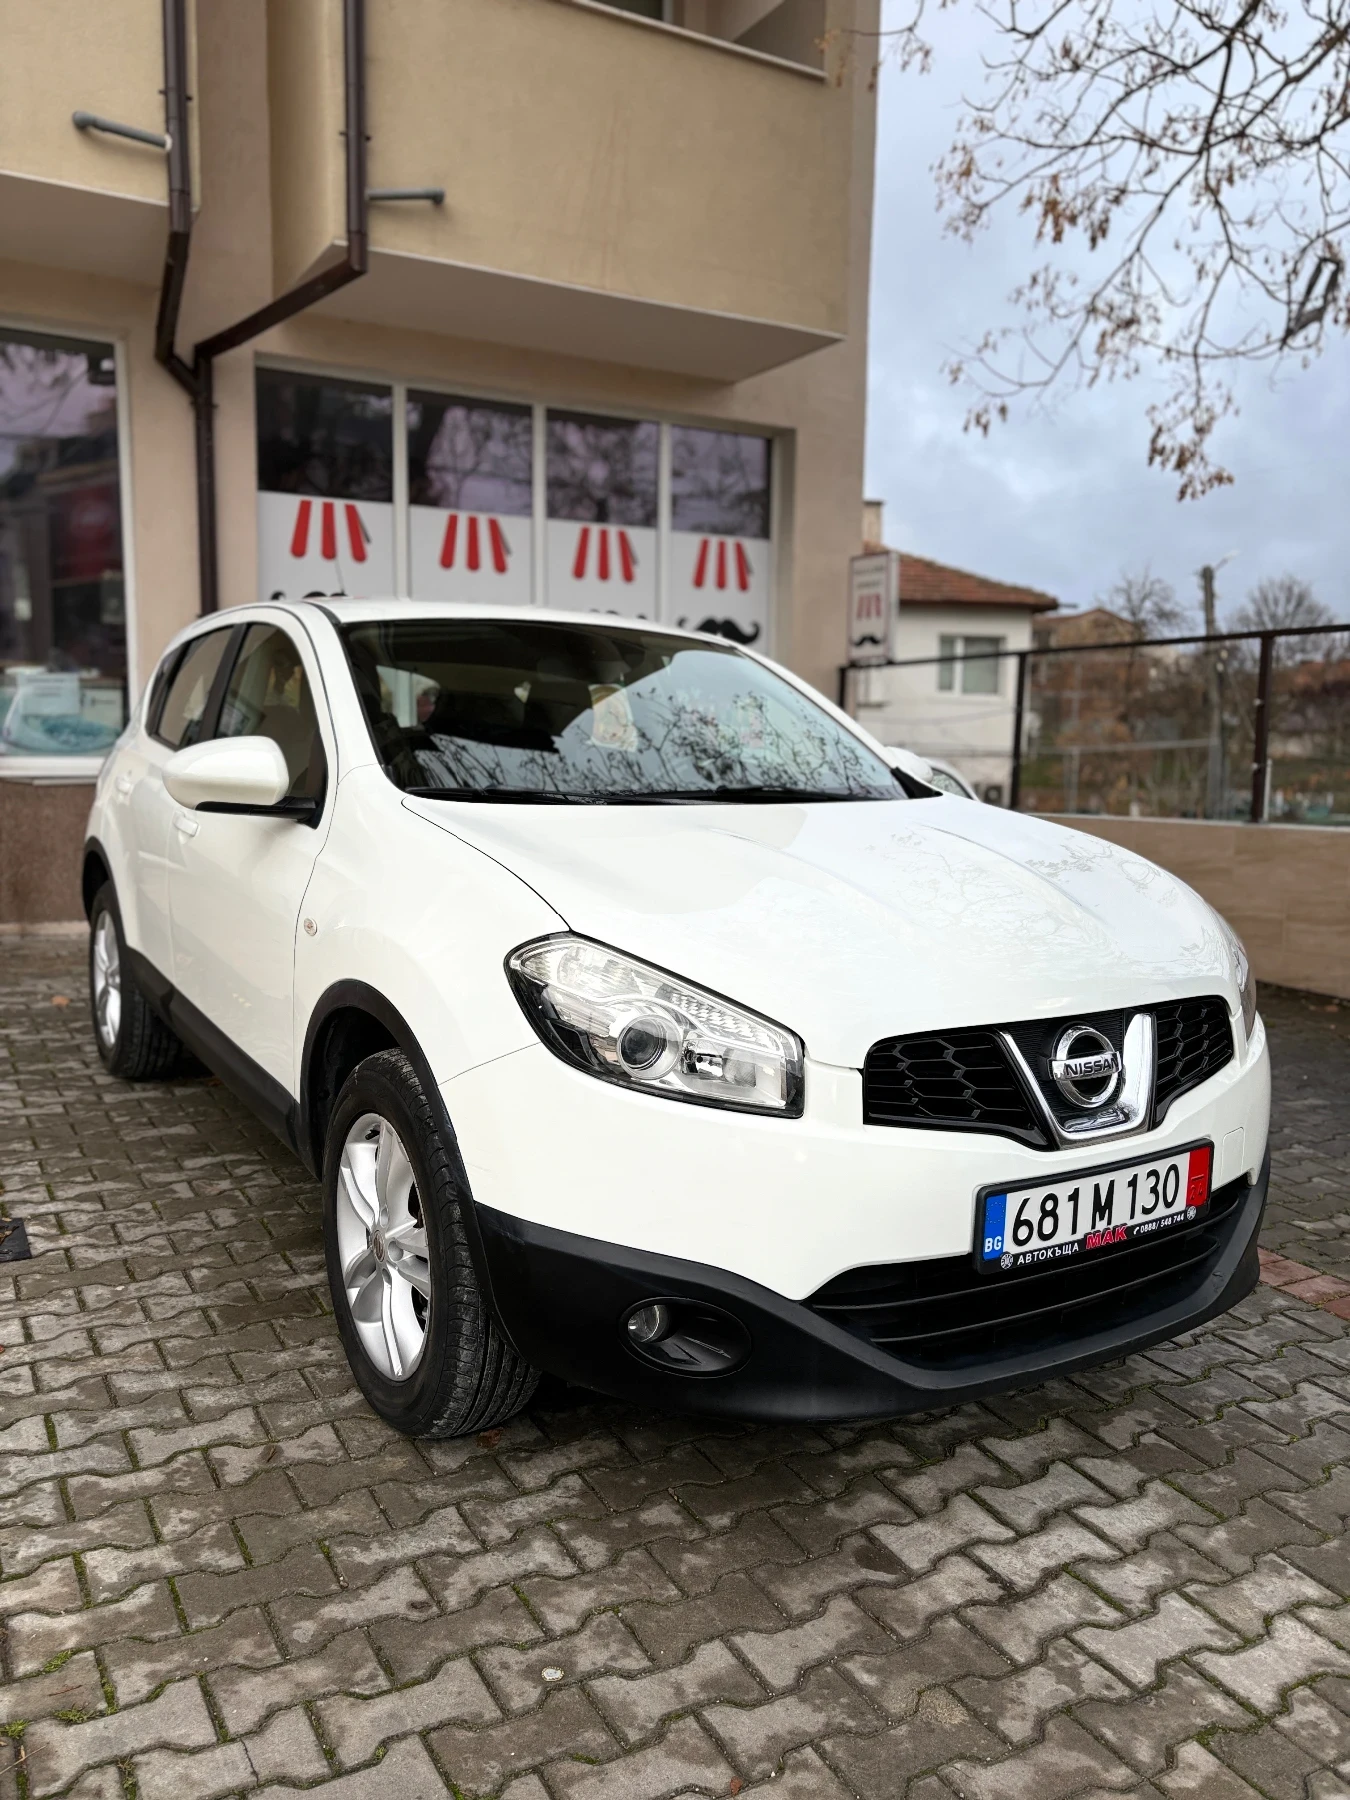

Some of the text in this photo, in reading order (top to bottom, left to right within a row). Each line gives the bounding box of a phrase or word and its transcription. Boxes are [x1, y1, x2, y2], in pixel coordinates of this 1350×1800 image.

[1064, 1053, 1119, 1077] NISSAN
[984, 1235, 1002, 1253] BG
[1017, 1242, 1080, 1266] АВТОКЪЩА
[1086, 1223, 1127, 1249] МАК
